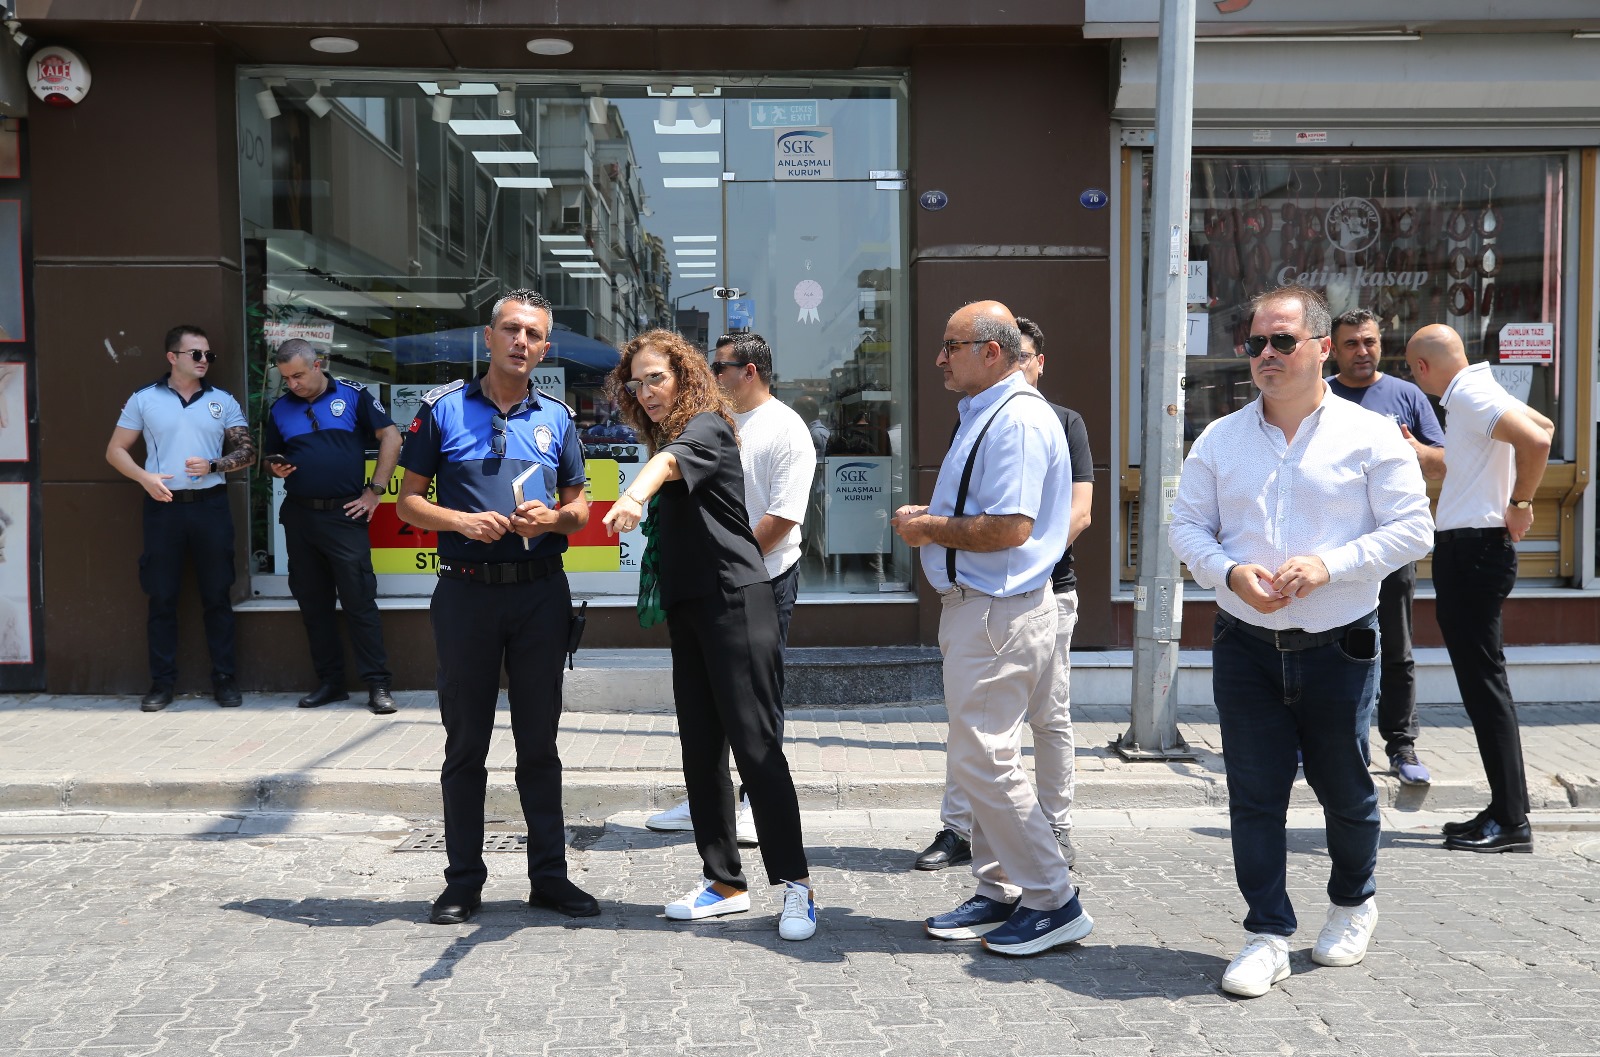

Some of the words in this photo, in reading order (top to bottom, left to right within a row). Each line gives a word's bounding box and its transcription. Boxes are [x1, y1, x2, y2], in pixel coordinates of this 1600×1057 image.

[38, 62, 71, 80] KALE
[783, 140, 815, 154] SGK
[1089, 194, 1099, 203] 76
[1354, 266, 1429, 291] kasap
[1508, 326, 1530, 336] GÜNLÜK
[1531, 328, 1544, 336] TAZE
[1526, 339, 1551, 347] BULUNUR
[533, 376, 562, 384] ADA
[1493, 369, 1530, 385] ARIŞIK
[840, 470, 868, 481] SGK
